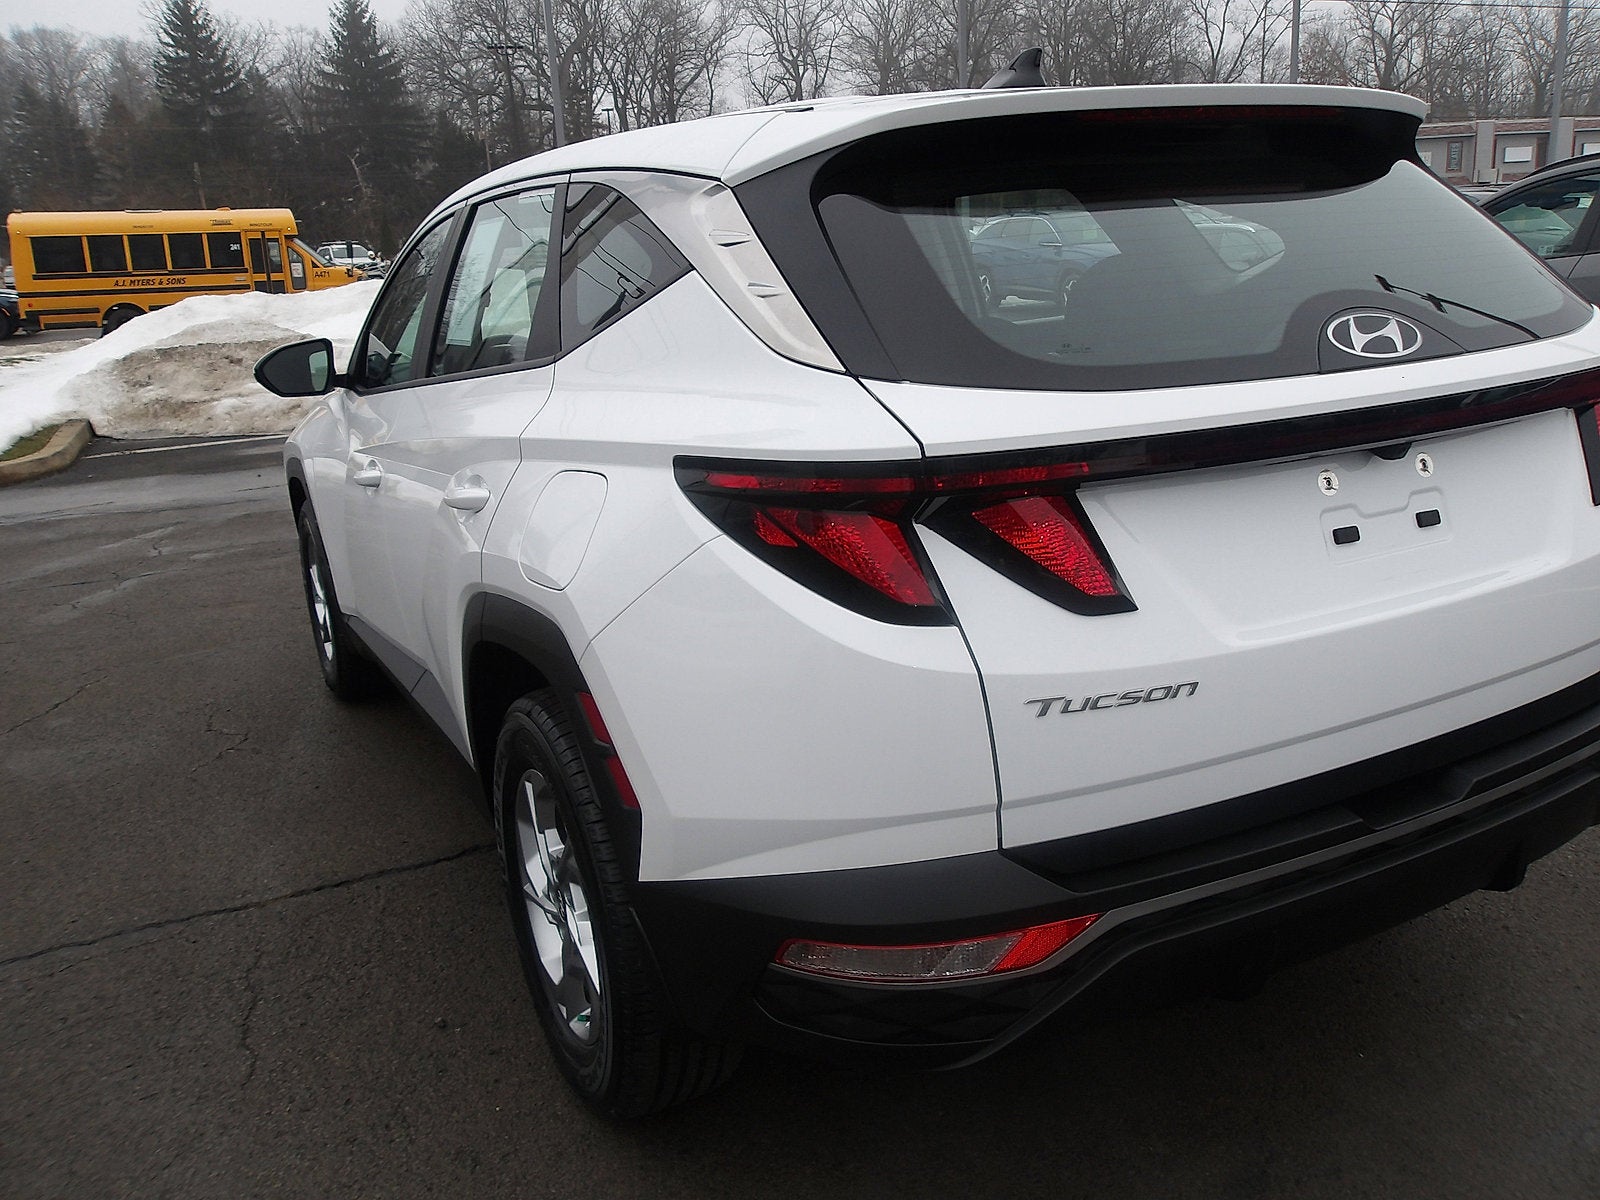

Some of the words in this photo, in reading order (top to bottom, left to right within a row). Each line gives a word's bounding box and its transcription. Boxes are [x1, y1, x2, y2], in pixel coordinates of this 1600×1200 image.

[129, 278, 156, 287] MYERS
[158, 278, 164, 286] &
[166, 277, 186, 286] SONS
